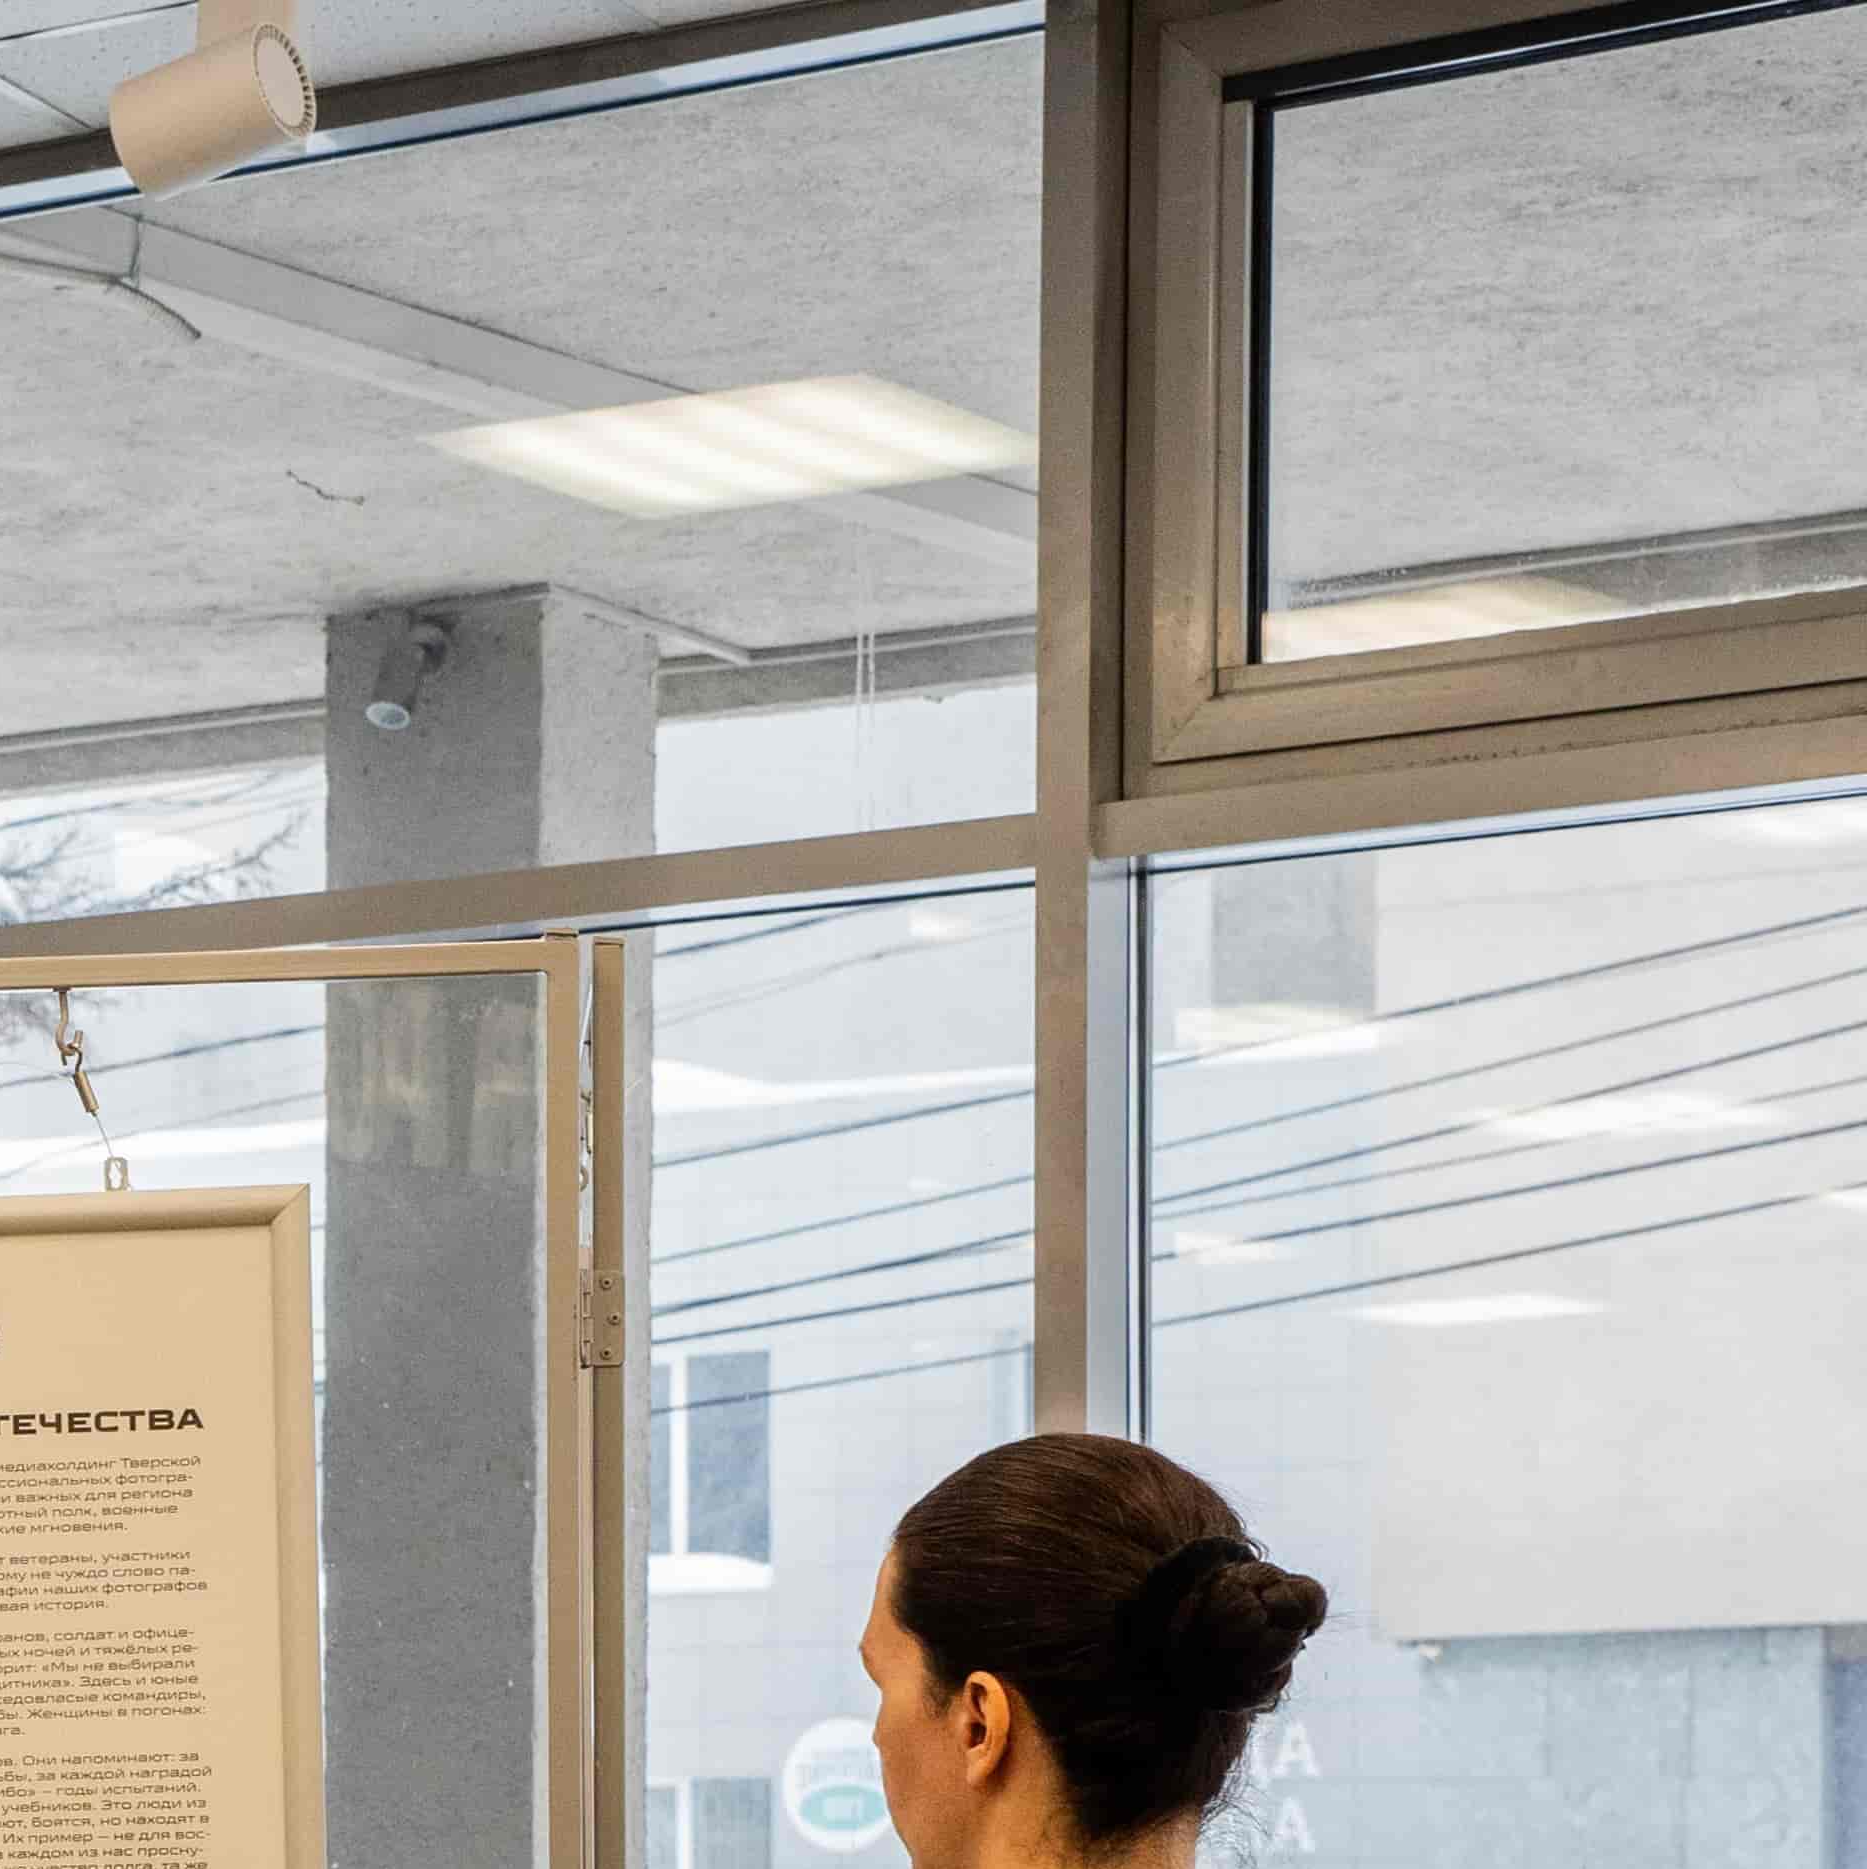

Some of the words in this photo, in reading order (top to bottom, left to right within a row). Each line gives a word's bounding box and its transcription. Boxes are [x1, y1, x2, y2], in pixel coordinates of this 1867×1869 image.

[120, 1455, 200, 1469] Тверской
[115, 1472, 192, 1485] фотогра-
[15, 1492, 81, 1502] важных
[84, 1491, 116, 1501] для
[121, 1489, 193, 1499] региона
[52, 1507, 96, 1518] полк,
[101, 1505, 178, 1515] военные
[30, 1521, 127, 1533] мгновения.
[9, 1554, 97, 1565] ветераны,
[101, 1551, 190, 1562] участники
[30, 1571, 51, 1579] не
[55, 1569, 108, 1581] чуждо
[112, 1567, 164, 1577] слово
[169, 1566, 195, 1575] па-
[43, 1585, 98, 1595] наших
[102, 1580, 207, 1594] фотографов
[34, 1600, 107, 1611] история.
[53, 1631, 114, 1641] солдат
[118, 1631, 128, 1639] и
[132, 1627, 194, 1639] офице-
[23, 1647, 75, 1657] ночей
[79, 1647, 90, 1656] и
[93, 1644, 167, 1655] тяжёлых
[171, 1644, 197, 1655] ре-
[42, 1661, 78, 1672] «Мы
[82, 1662, 104, 1671] не
[107, 1657, 195, 1671] выбирали
[22, 1754, 56, 1766] Они
[61, 1753, 174, 1765] напоминают:
[178, 1752, 199, 1761] за
